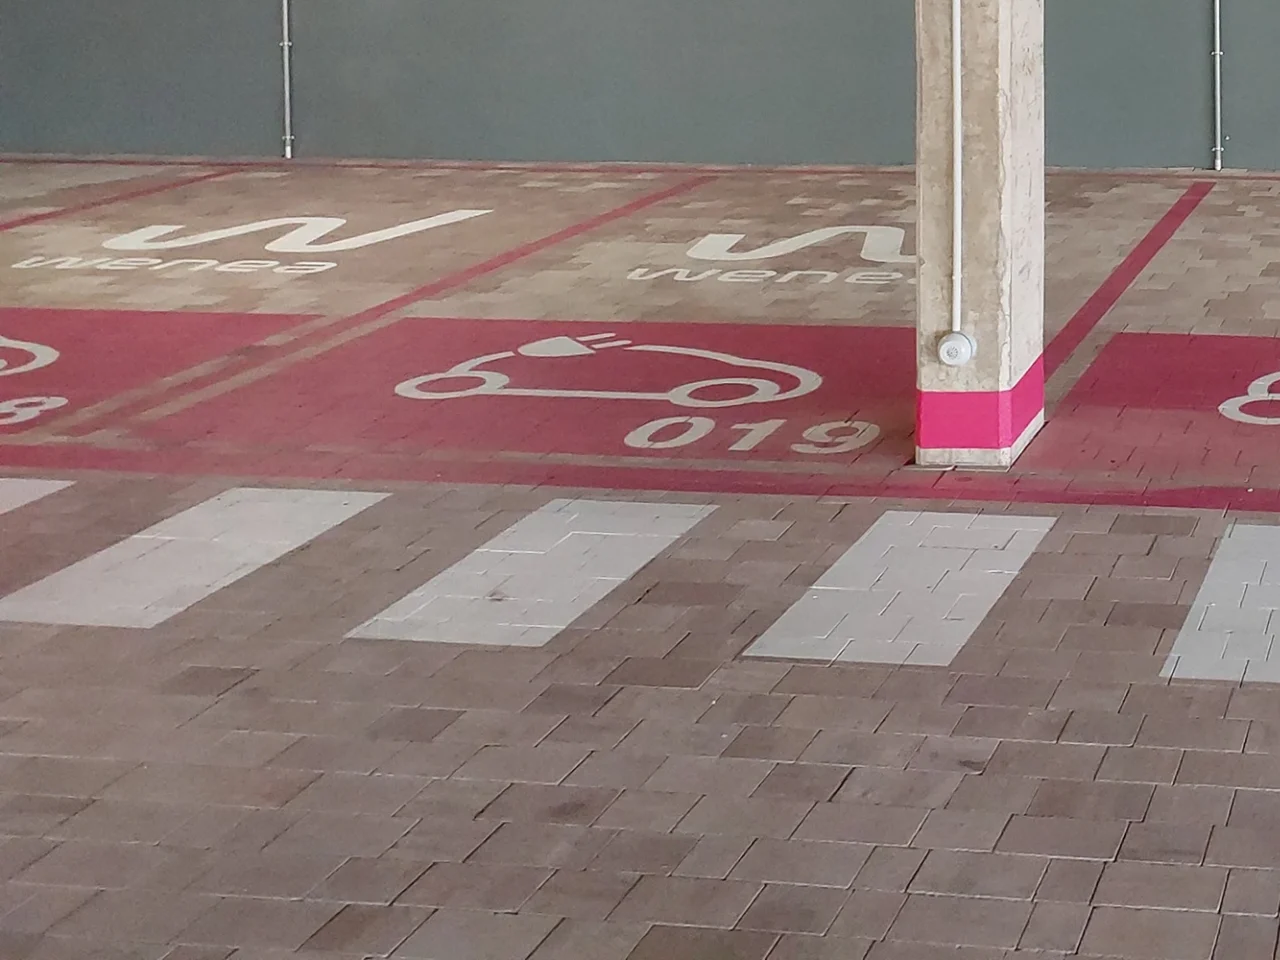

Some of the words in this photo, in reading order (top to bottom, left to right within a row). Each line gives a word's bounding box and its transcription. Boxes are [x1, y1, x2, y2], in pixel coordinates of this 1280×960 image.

[11, 254, 338, 274] wenea
[627, 267, 916, 285] wene
[624, 416, 880, 454] 019
